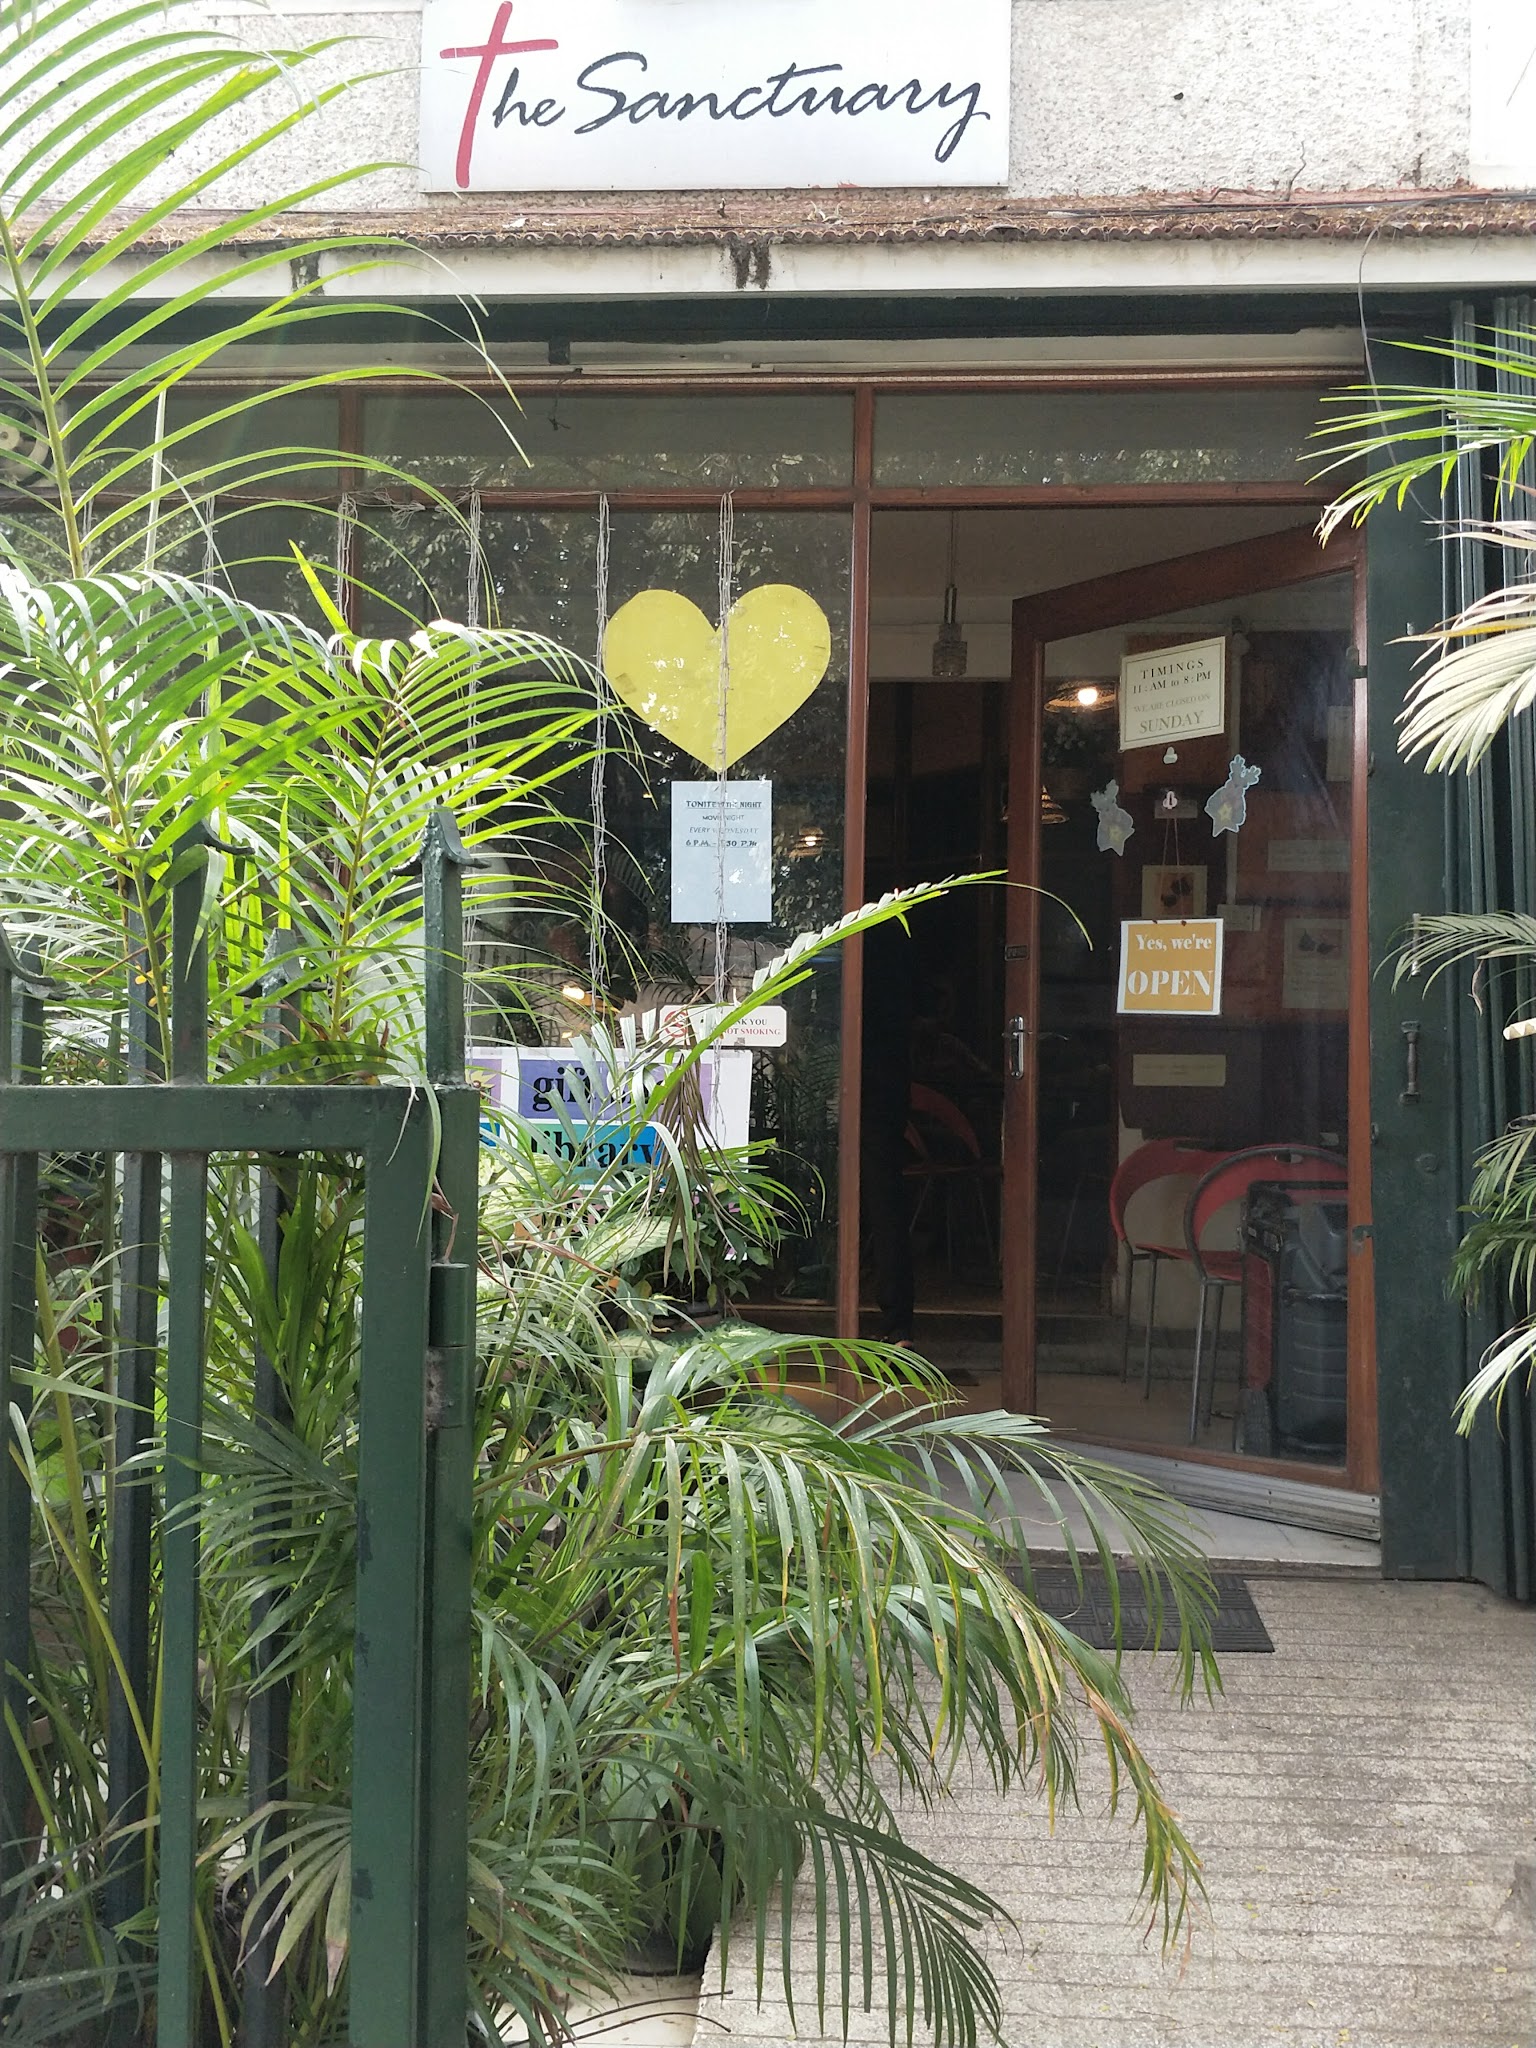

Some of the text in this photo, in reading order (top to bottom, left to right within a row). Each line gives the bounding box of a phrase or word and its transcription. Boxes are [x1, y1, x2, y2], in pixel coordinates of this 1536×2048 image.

[574, 51, 991, 164] Sanctuary
[1141, 658, 1205, 679] TIMINGS
[1139, 710, 1204, 734] SUNDAY
[689, 826, 711, 834] EVERY
[1135, 933, 1213, 952] Yes, we're
[1127, 970, 1213, 996] OPEN
[749, 1018, 768, 1026] YOU
[530, 1129, 662, 1169] lbrar
